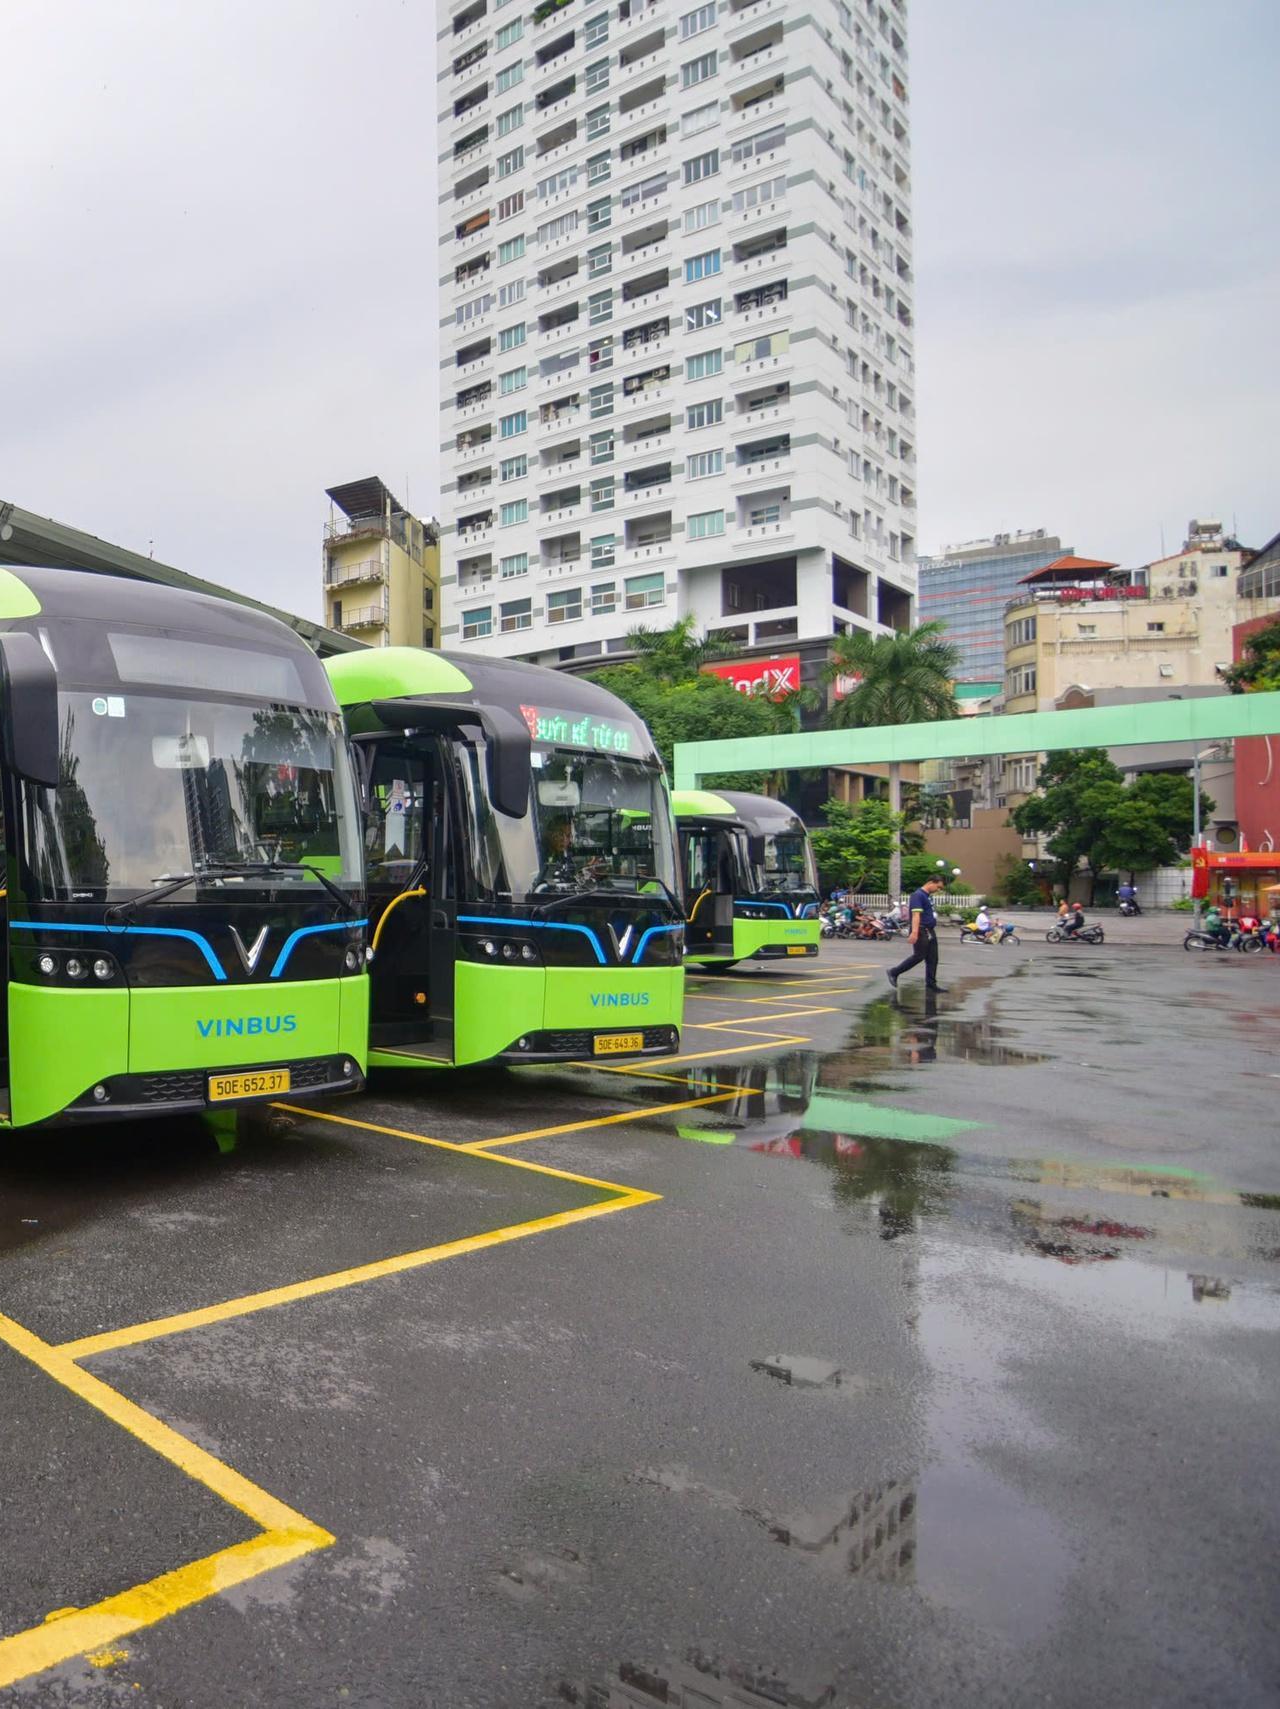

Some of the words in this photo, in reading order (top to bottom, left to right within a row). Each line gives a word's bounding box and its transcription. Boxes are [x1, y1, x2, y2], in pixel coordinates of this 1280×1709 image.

[590, 992, 650, 1007] VINBUS
[196, 1015, 298, 1038] VINBUS
[217, 1075, 283, 1096] 50E-652.37
